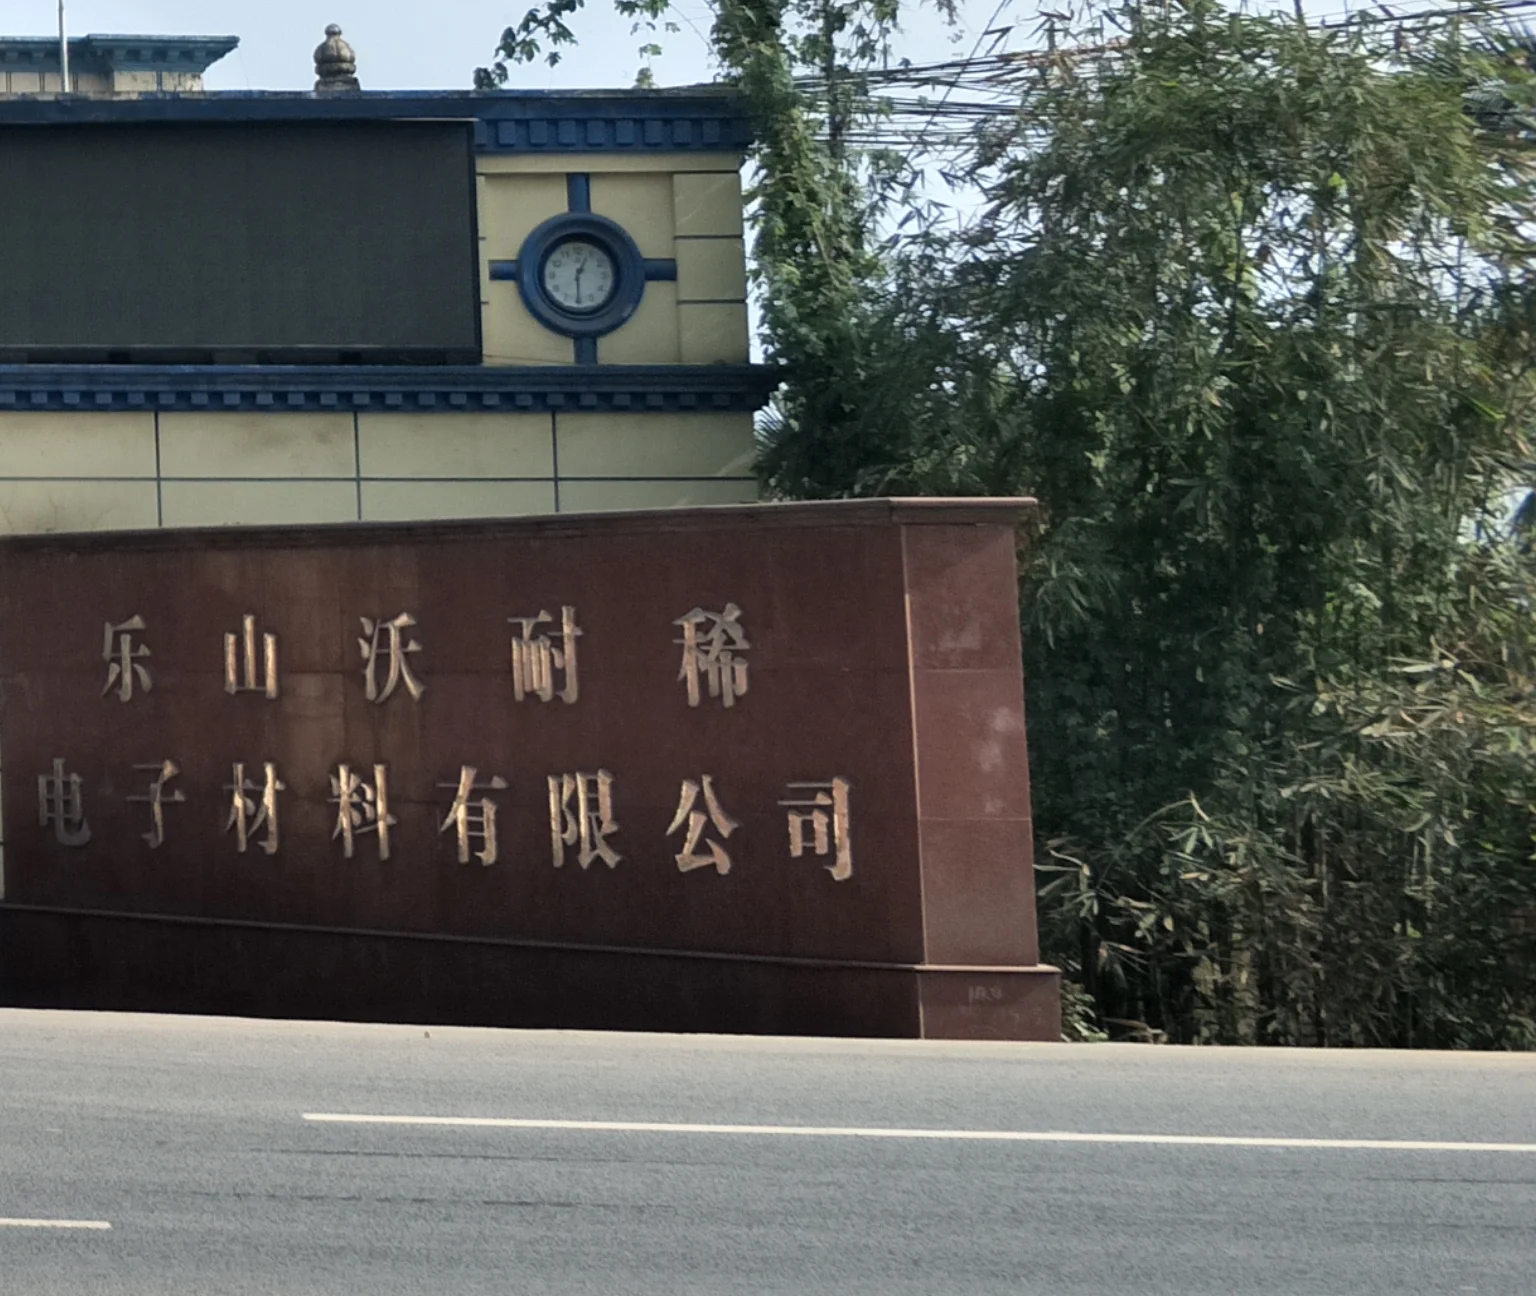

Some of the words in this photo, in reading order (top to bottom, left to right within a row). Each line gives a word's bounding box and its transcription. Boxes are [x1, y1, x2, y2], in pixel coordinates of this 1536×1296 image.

[101, 602, 750, 707] 乐山沃耐稀
[37, 757, 853, 881] 电子材料有限公司
